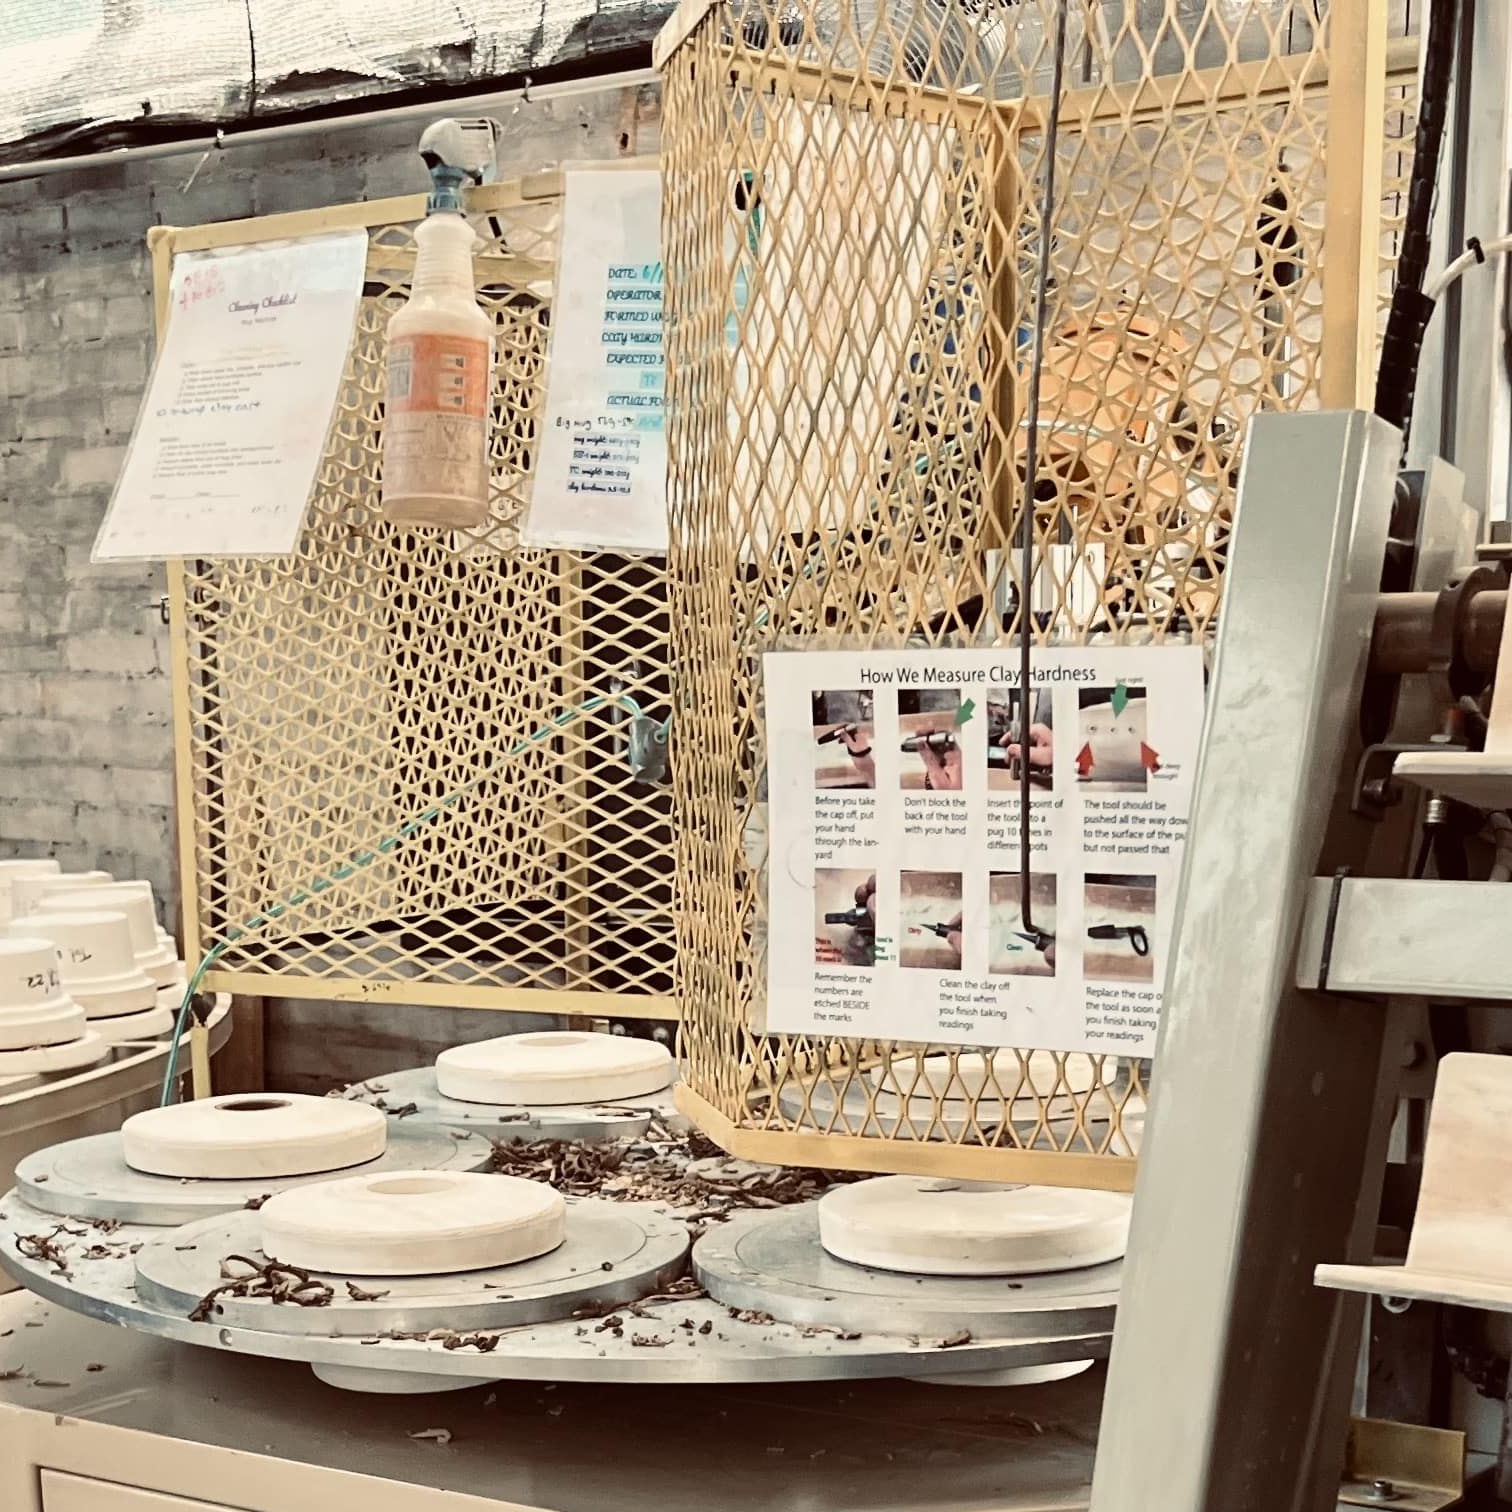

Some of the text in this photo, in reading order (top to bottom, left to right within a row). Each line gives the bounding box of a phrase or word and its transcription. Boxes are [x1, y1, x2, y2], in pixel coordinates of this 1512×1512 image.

[604, 310, 648, 321] FORMED
[607, 353, 656, 364] EXPECTED
[861, 668, 893, 683] How
[897, 667, 920, 683] We
[923, 667, 986, 683] Measure
[989, 664, 1022, 685] Clay
[815, 796, 876, 807] Before you take
[904, 797, 967, 807] Don't block the
[987, 799, 1012, 808] Insert
[1054, 799, 1064, 809] of
[1085, 799, 1167, 811] The tool should be
[815, 810, 828, 819] the
[830, 812, 845, 820] cap
[860, 811, 874, 821] put
[905, 811, 968, 821] back of the tool
[987, 813, 1001, 822] the
[1003, 813, 1021, 823] tool
[1041, 815, 1046, 823] a
[1083, 815, 1117, 825] pushed
[1119, 815, 1129, 824] all
[1131, 816, 1146, 825] the
[1149, 817, 1167, 826] way
[815, 823, 856, 834] your hand
[904, 826, 967, 836] with your hand
[987, 828, 1004, 838] pug
[1007, 828, 1017, 836] 10
[1083, 829, 1093, 838] to
[1094, 829, 1109, 839] the
[1111, 830, 1144, 840] surface
[1146, 830, 1156, 839] of
[1157, 830, 1172, 839] the
[815, 837, 847, 849] through
[848, 838, 862, 847] the
[987, 840, 1022, 850] differen
[1083, 843, 1170, 856] but not passed that
[814, 851, 833, 861] yard
[815, 972, 873, 984] Remember the
[939, 978, 1011, 992] Clean the clay off
[814, 986, 864, 997] numbers are
[1086, 986, 1120, 998] Replace
[1121, 989, 1136, 999] the
[1138, 992, 1155, 1001] cap
[939, 993, 997, 1004] the tool when
[814, 999, 870, 1010] etched BESIDE
[1086, 1001, 1100, 1010] the
[1102, 1002, 1120, 1011] tool
[1121, 1005, 1130, 1013] as
[1132, 1006, 1154, 1014] soon
[814, 1012, 853, 1022] the marks
[939, 1006, 1008, 1021] you finish taking
[939, 1019, 974, 1031] readings
[1085, 1016, 1157, 1031] you finish taking
[1085, 1030, 1144, 1043] your readings
